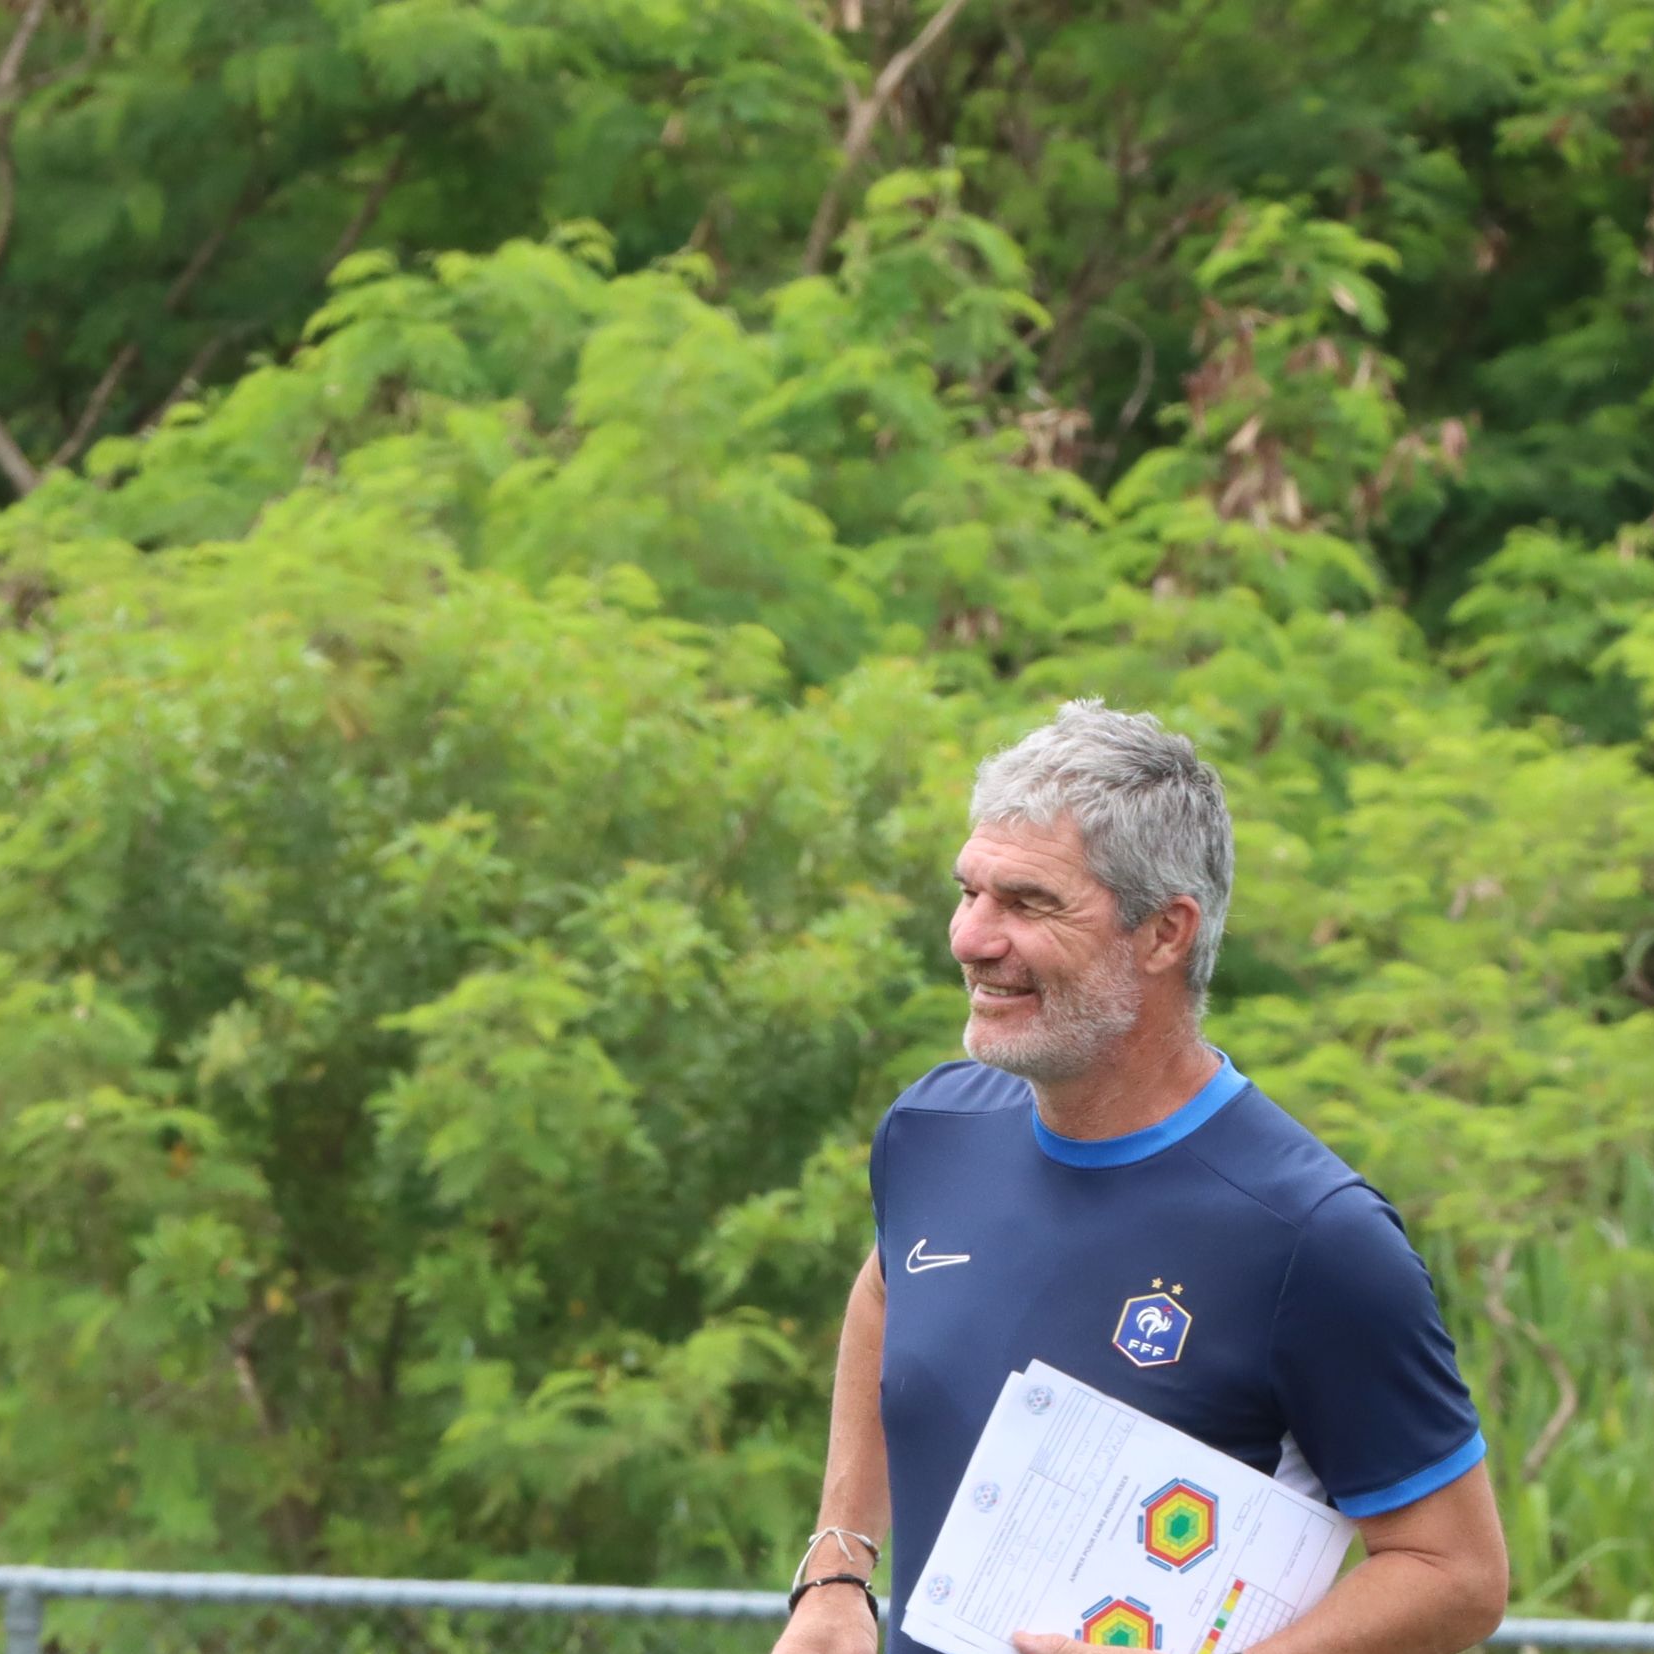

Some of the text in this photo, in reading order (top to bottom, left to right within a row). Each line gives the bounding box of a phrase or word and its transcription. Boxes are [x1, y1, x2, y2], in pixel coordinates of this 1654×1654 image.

[1128, 1339, 1165, 1357] FFF
[1080, 1535, 1097, 1557] POUR
[1091, 1517, 1107, 1538] FAIRE
[1100, 1473, 1130, 1519] PROGRESSER
